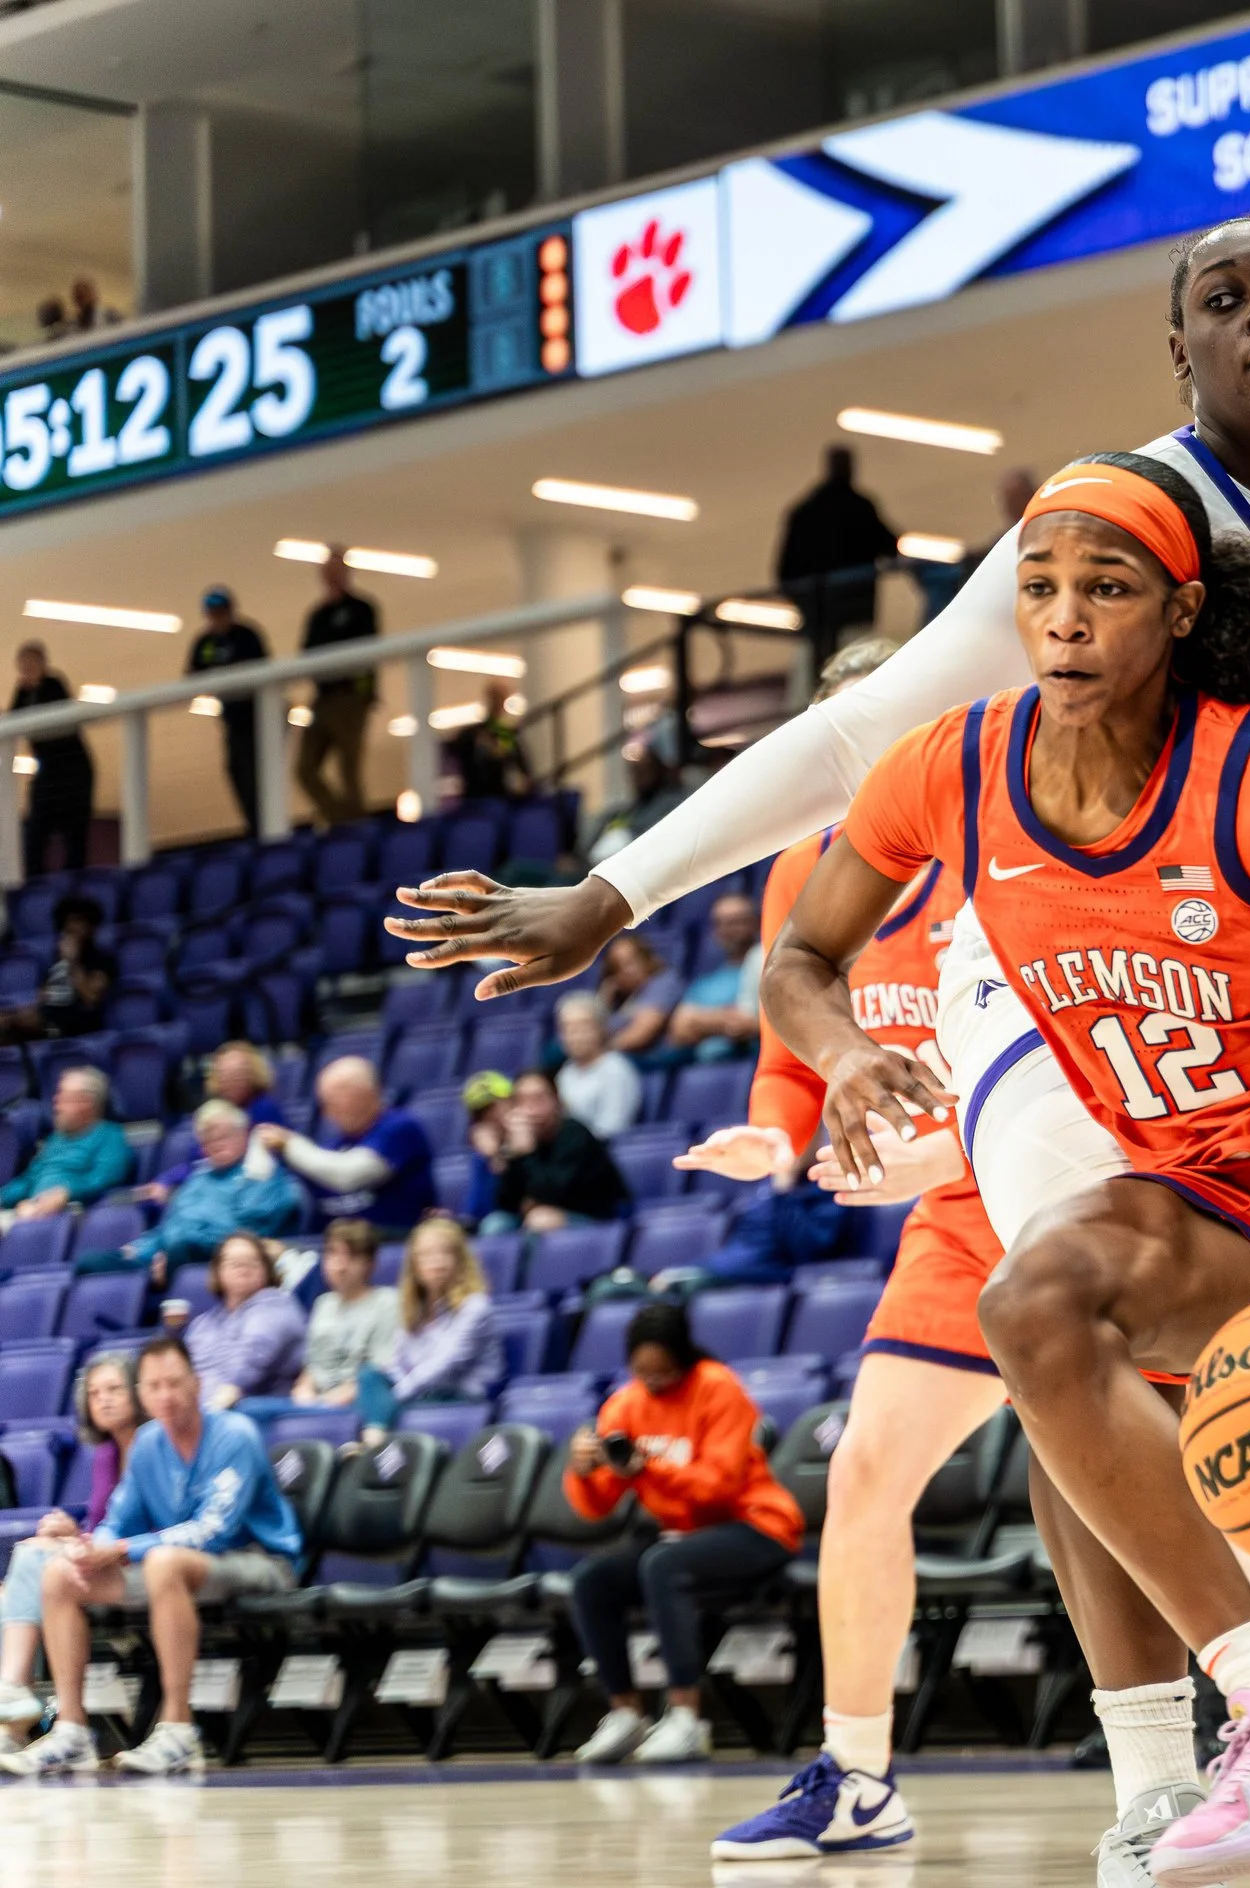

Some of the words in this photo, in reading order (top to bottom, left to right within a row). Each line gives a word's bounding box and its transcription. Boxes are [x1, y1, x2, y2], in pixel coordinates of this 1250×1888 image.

[187, 304, 316, 457] 25
[380, 326, 428, 411] 2
[0, 355, 172, 491] 5:12
[1181, 913, 1212, 925] ACC
[850, 982, 939, 1031] LEMSO
[1088, 1012, 1250, 1121] 12
